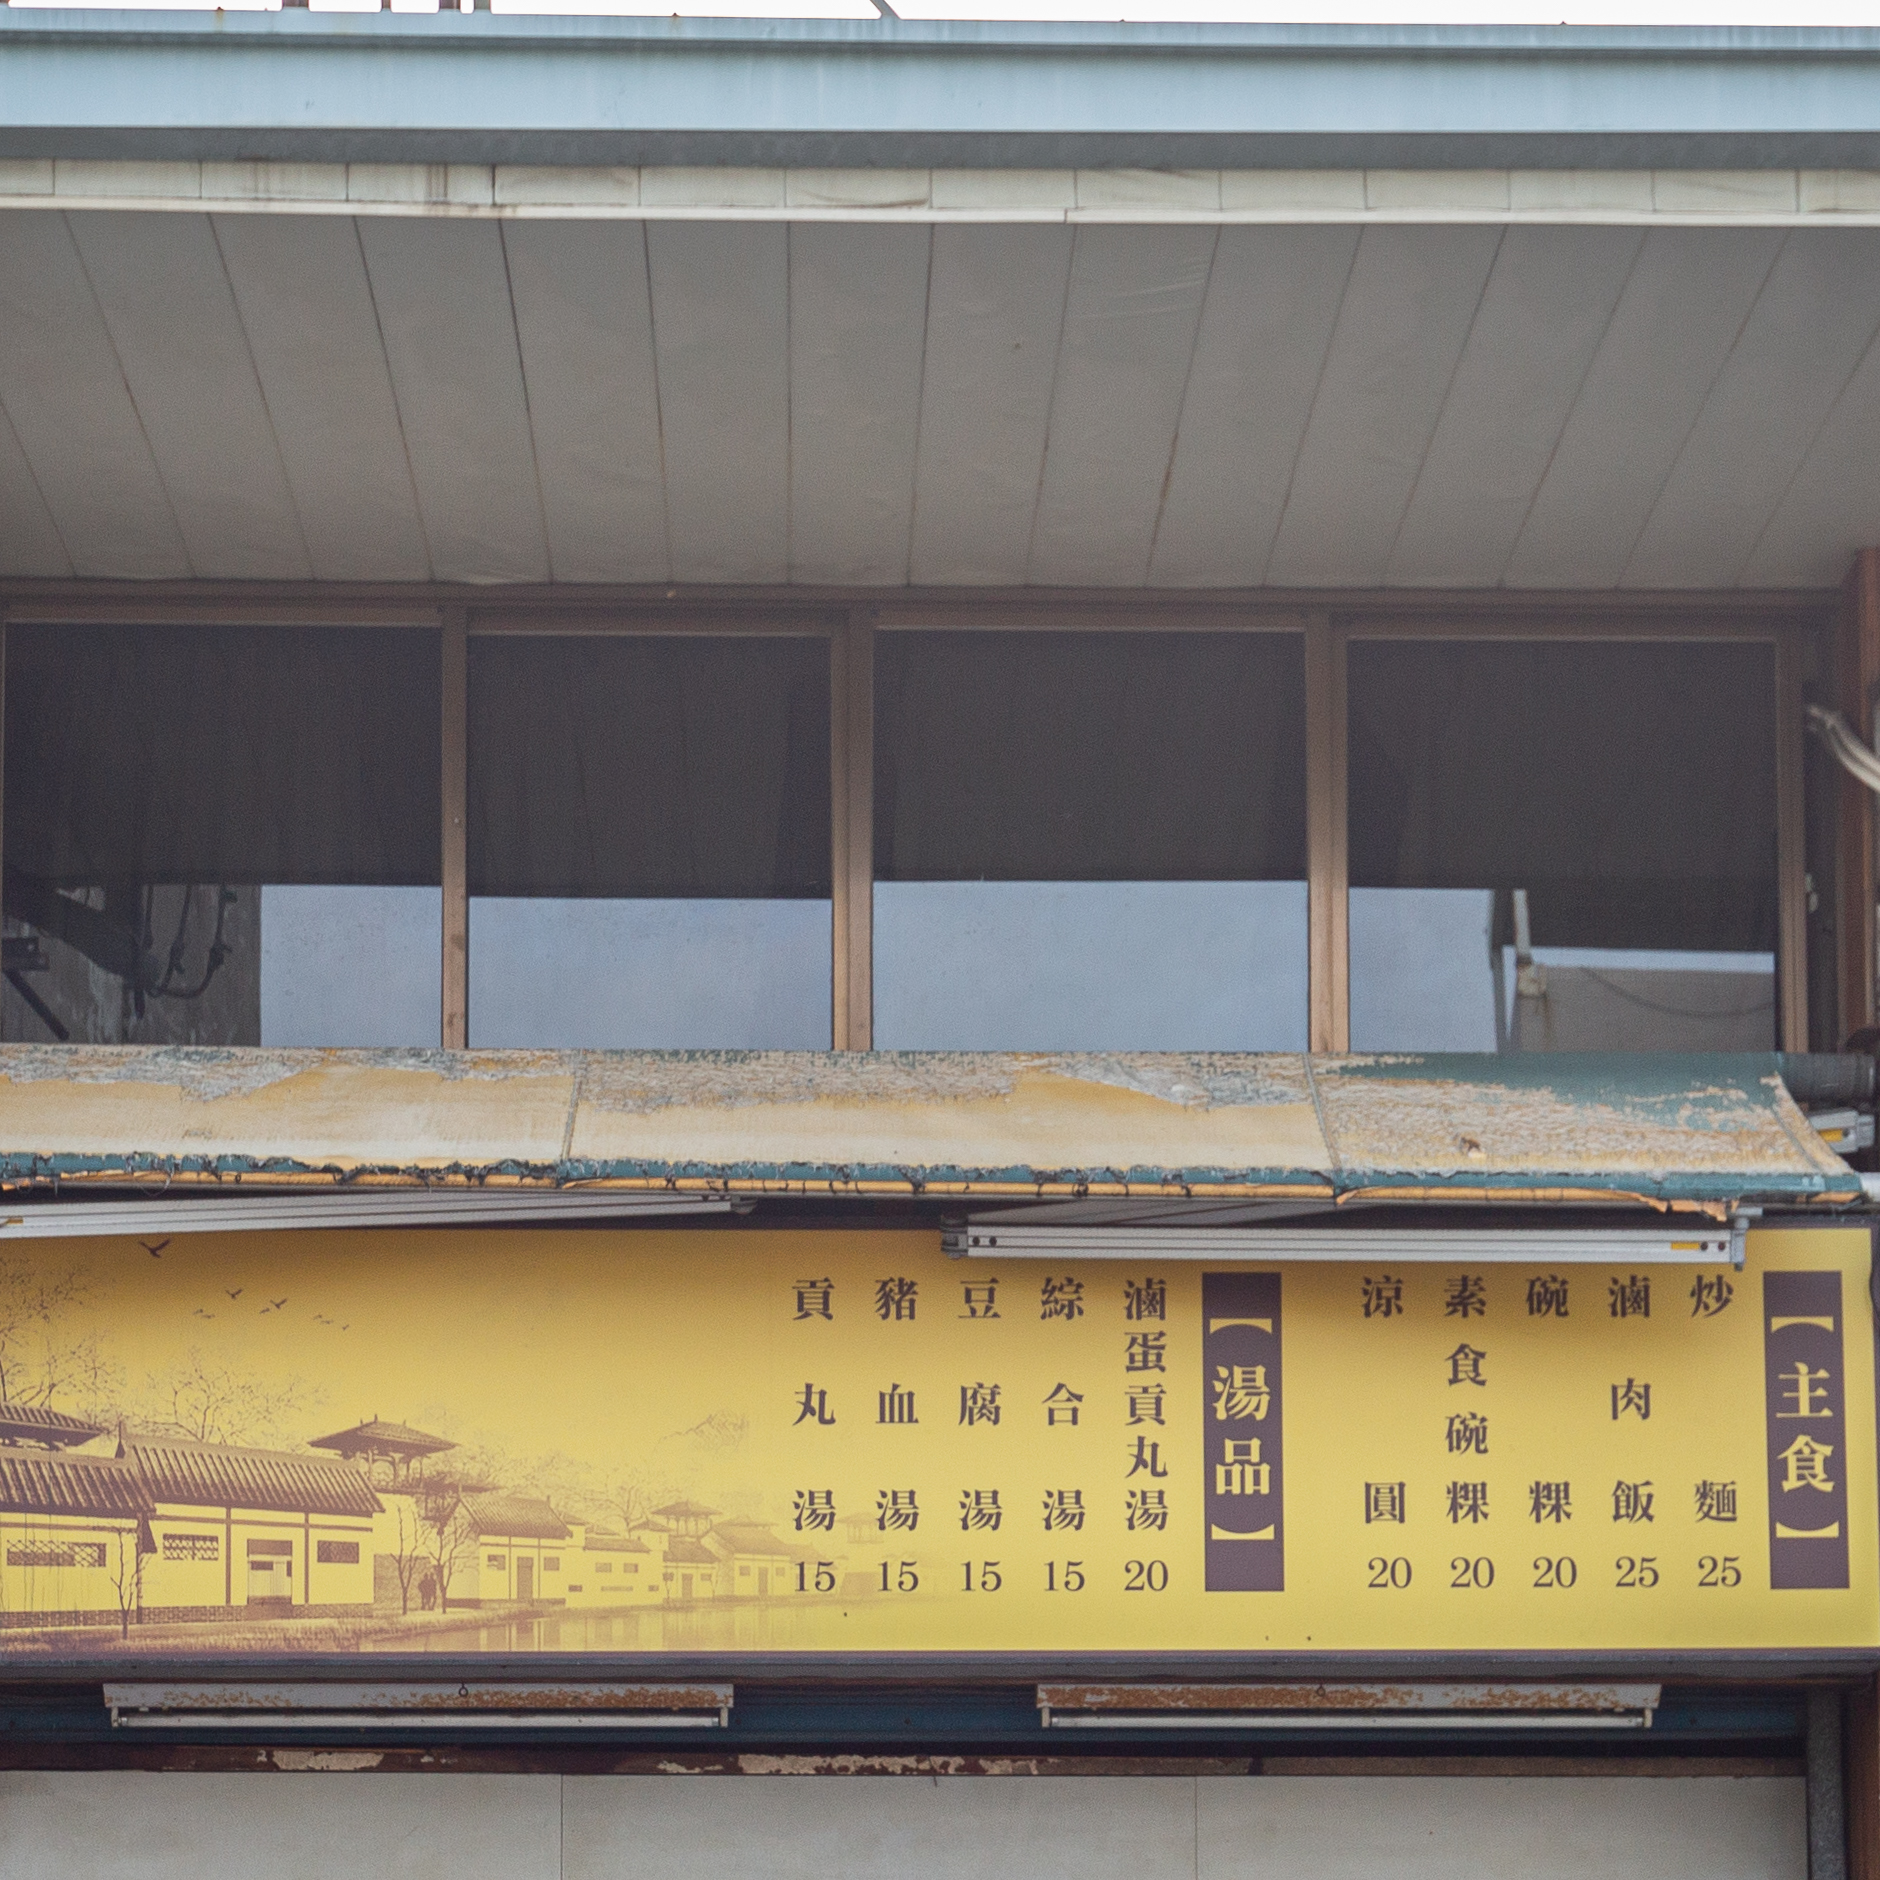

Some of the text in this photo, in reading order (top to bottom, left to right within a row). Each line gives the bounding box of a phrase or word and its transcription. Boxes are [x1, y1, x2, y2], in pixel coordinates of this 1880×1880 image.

[791, 1276, 836, 1532] 貢丸湯
[874, 1276, 920, 1532] 豬血湯
[958, 1276, 1003, 1532] 豆腐湯
[1040, 1276, 1086, 1532] 綜合湯
[1123, 1277, 1169, 1532] 滷蛋貢丸湯
[1361, 1274, 1407, 1525] 涼圓
[1444, 1274, 1490, 1524] 素食碗粿
[1526, 1274, 1572, 1524] 碗粿
[1608, 1274, 1655, 1524] 滷肉飯
[1690, 1274, 1738, 1524] 炒麵
[795, 1560, 836, 1593] 15
[878, 1560, 920, 1593] 15
[961, 1560, 1003, 1593] 15
[1044, 1560, 1086, 1593] 15
[1123, 1559, 1169, 1593] 20
[1367, 1556, 1412, 1590] 20
[1449, 1556, 1495, 1590] 20
[1533, 1556, 1578, 1589] 20
[1615, 1556, 1659, 1589] 25
[1698, 1556, 1742, 1589] 25
